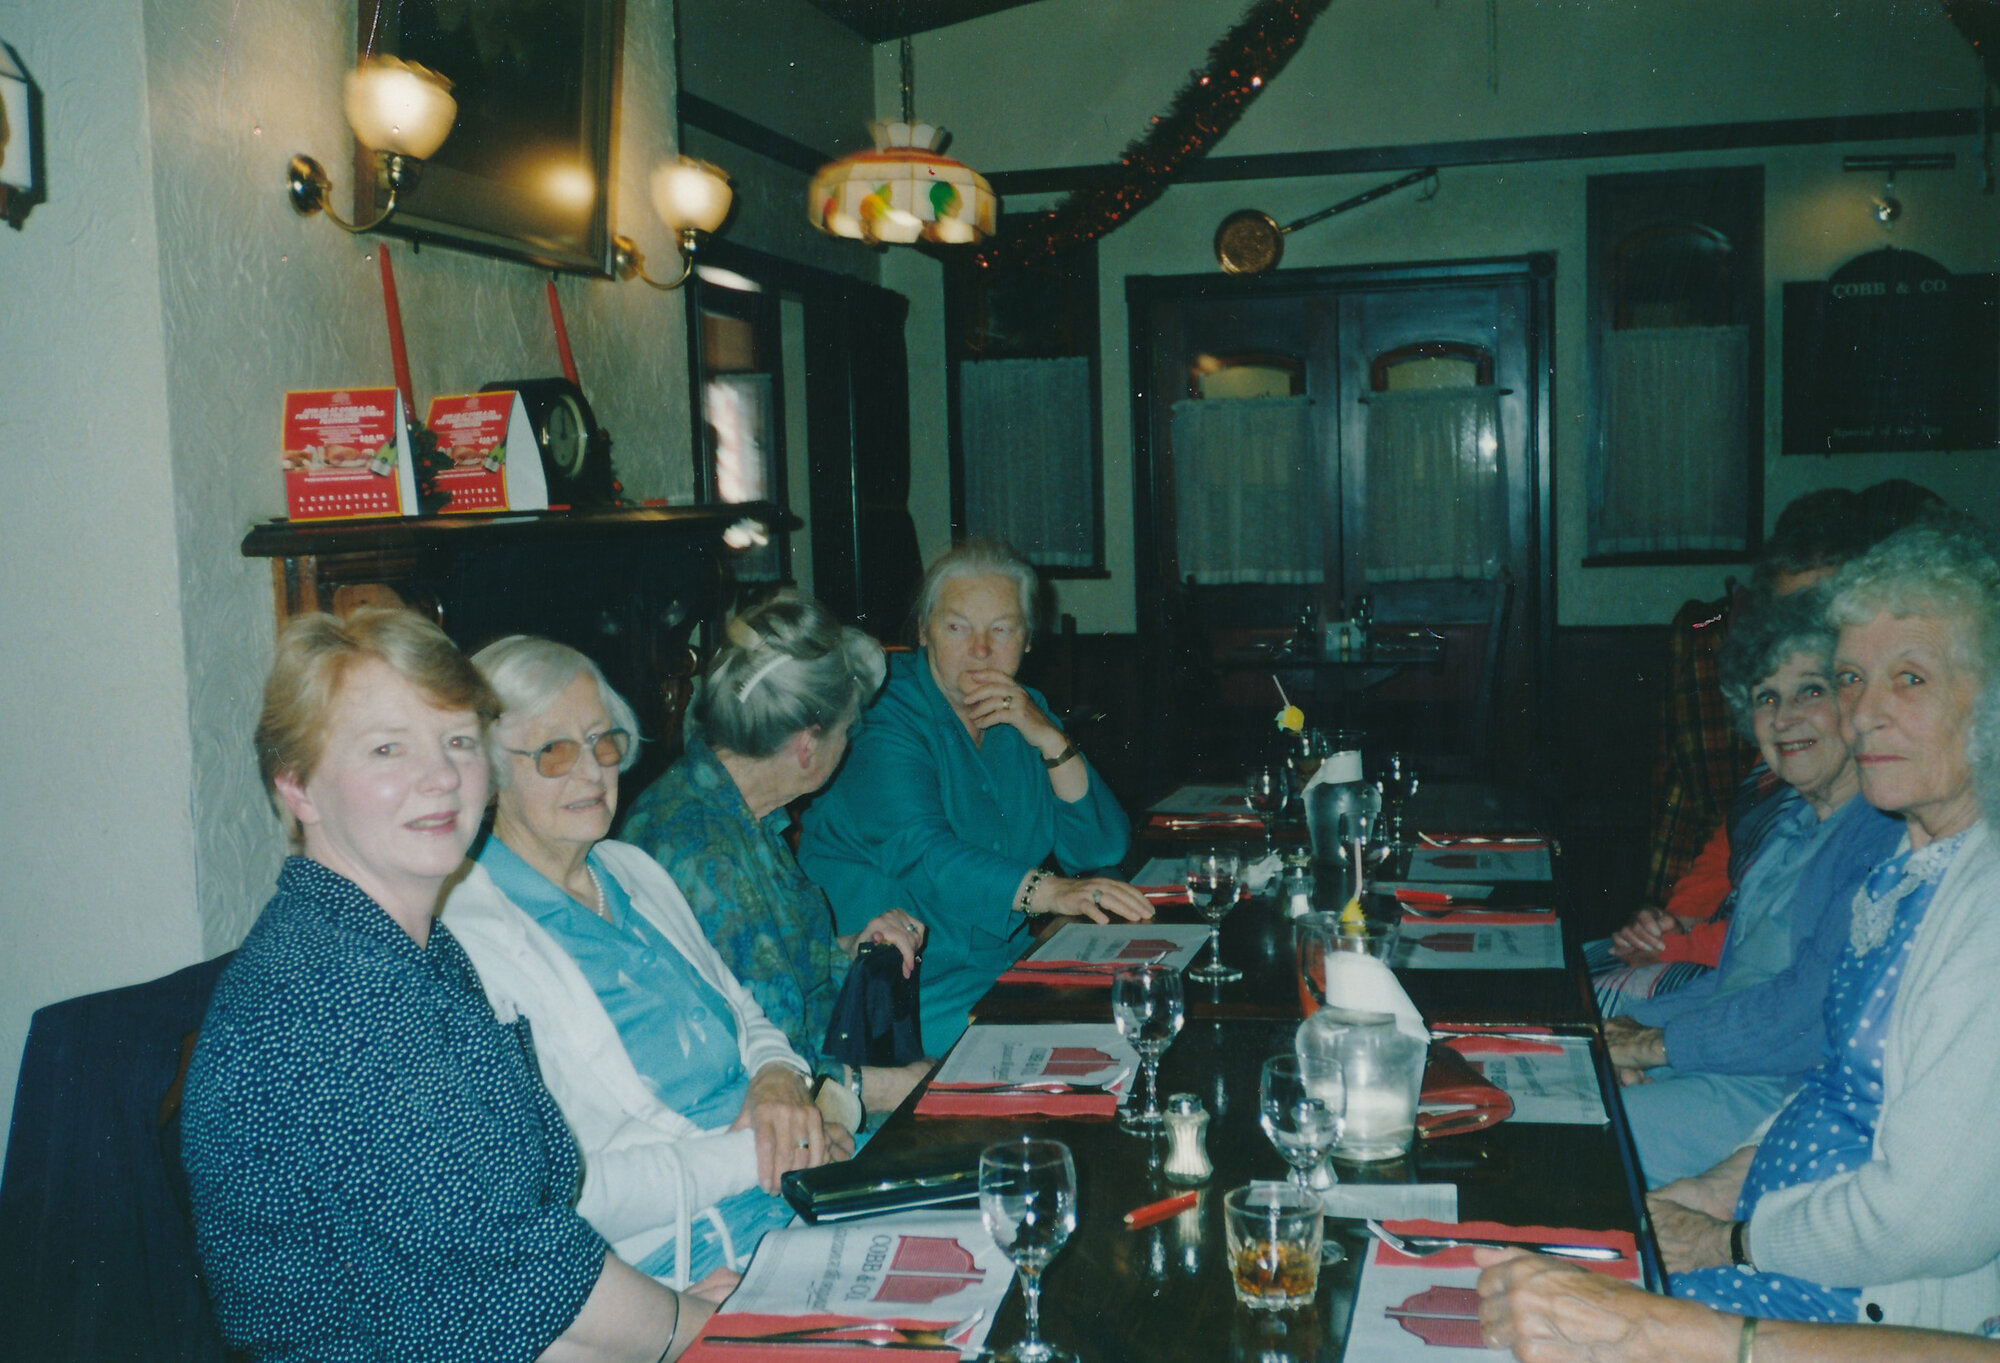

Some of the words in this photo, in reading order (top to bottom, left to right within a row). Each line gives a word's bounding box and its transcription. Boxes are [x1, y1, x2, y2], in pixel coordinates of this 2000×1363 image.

[1831, 282, 1886, 297] COBB
[1896, 281, 1909, 294] &
[310, 491, 388, 502] CHRISTMAS
[299, 501, 389, 512] INVITATION
[862, 1234, 892, 1273] COBB
[856, 1274, 876, 1285] &
